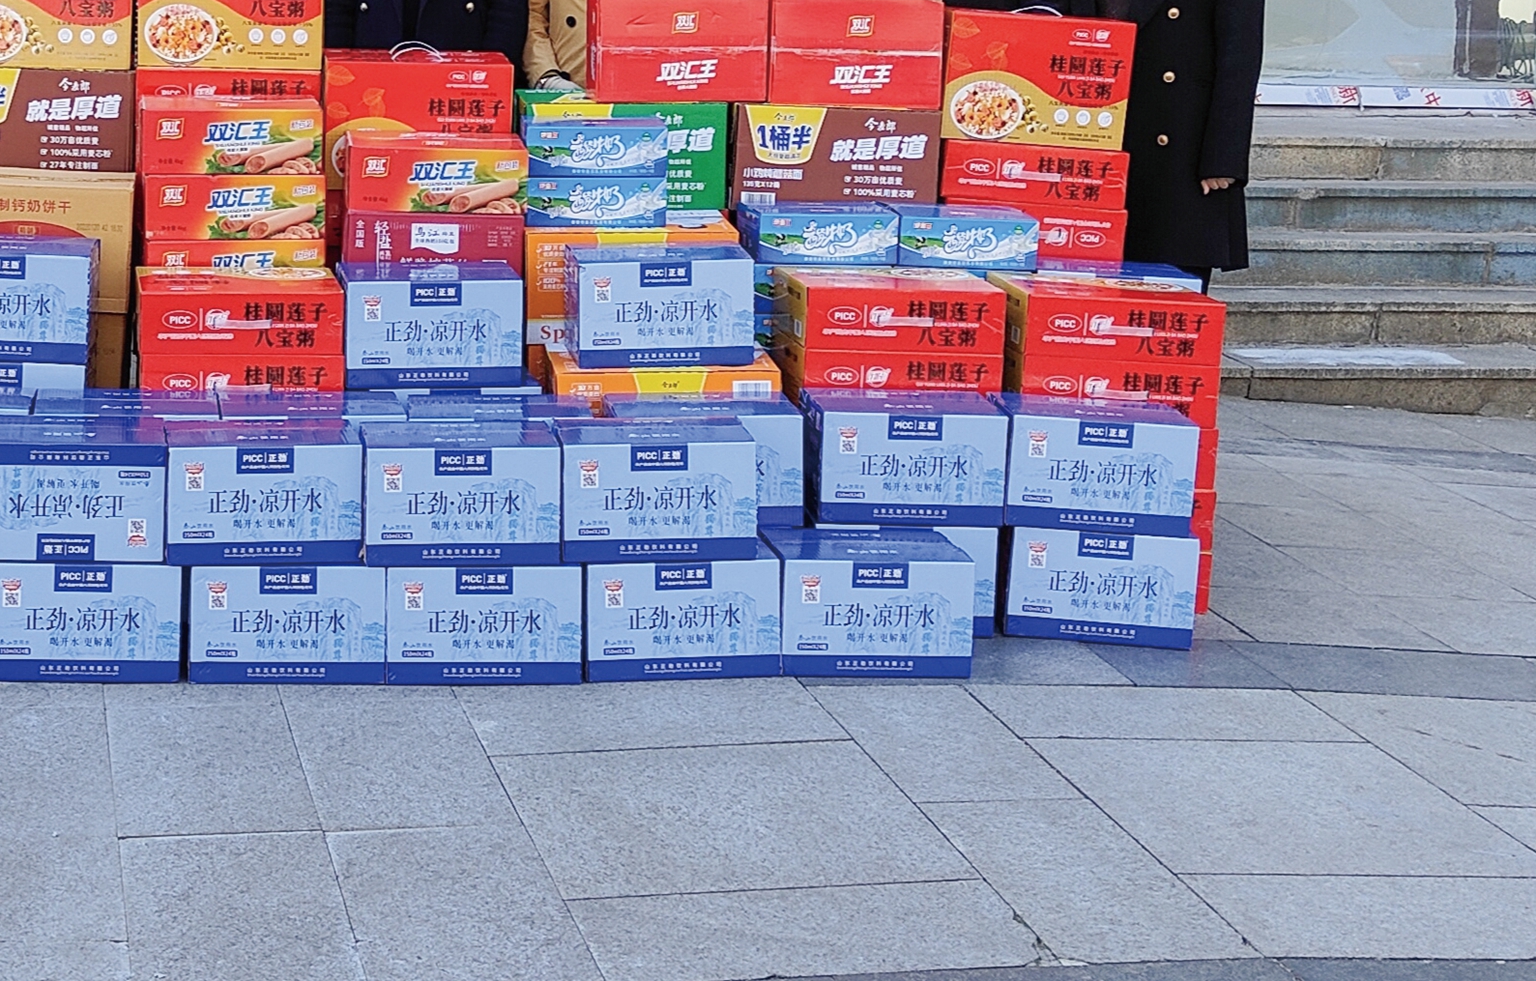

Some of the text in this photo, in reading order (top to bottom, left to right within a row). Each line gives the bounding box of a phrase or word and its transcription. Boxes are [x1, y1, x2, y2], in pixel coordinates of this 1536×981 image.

[59, 0, 114, 18] 八宝粥
[250, 0, 305, 18] 八宝粥
[656, 59, 718, 82] 双汇王
[829, 65, 893, 85] 双汇王
[1057, 80, 1112, 101] 八宝粥
[26, 95, 123, 122] 就是厚道
[204, 121, 270, 142] 双汇王
[757, 125, 812, 151] 1桶半
[829, 134, 928, 162] 就是厚道
[409, 161, 476, 182] 双汇王
[970, 163, 989, 172] PICC
[208, 187, 272, 208] 双汇王
[1044, 182, 1100, 202] 八宝粥
[645, 269, 664, 278] PICC
[416, 289, 434, 297] PICC
[169, 315, 191, 324] PICC
[834, 311, 856, 321] PICC
[1054, 319, 1076, 328] PICC
[255, 330, 314, 348] 八宝粥
[917, 328, 976, 347] 八宝粥
[1136, 337, 1195, 358] 八宝粥
[169, 379, 191, 388] PICC
[831, 372, 853, 381] PICC
[1049, 381, 1071, 390] PICC
[441, 456, 461, 464] PICC
[661, 570, 681, 579] PICC
